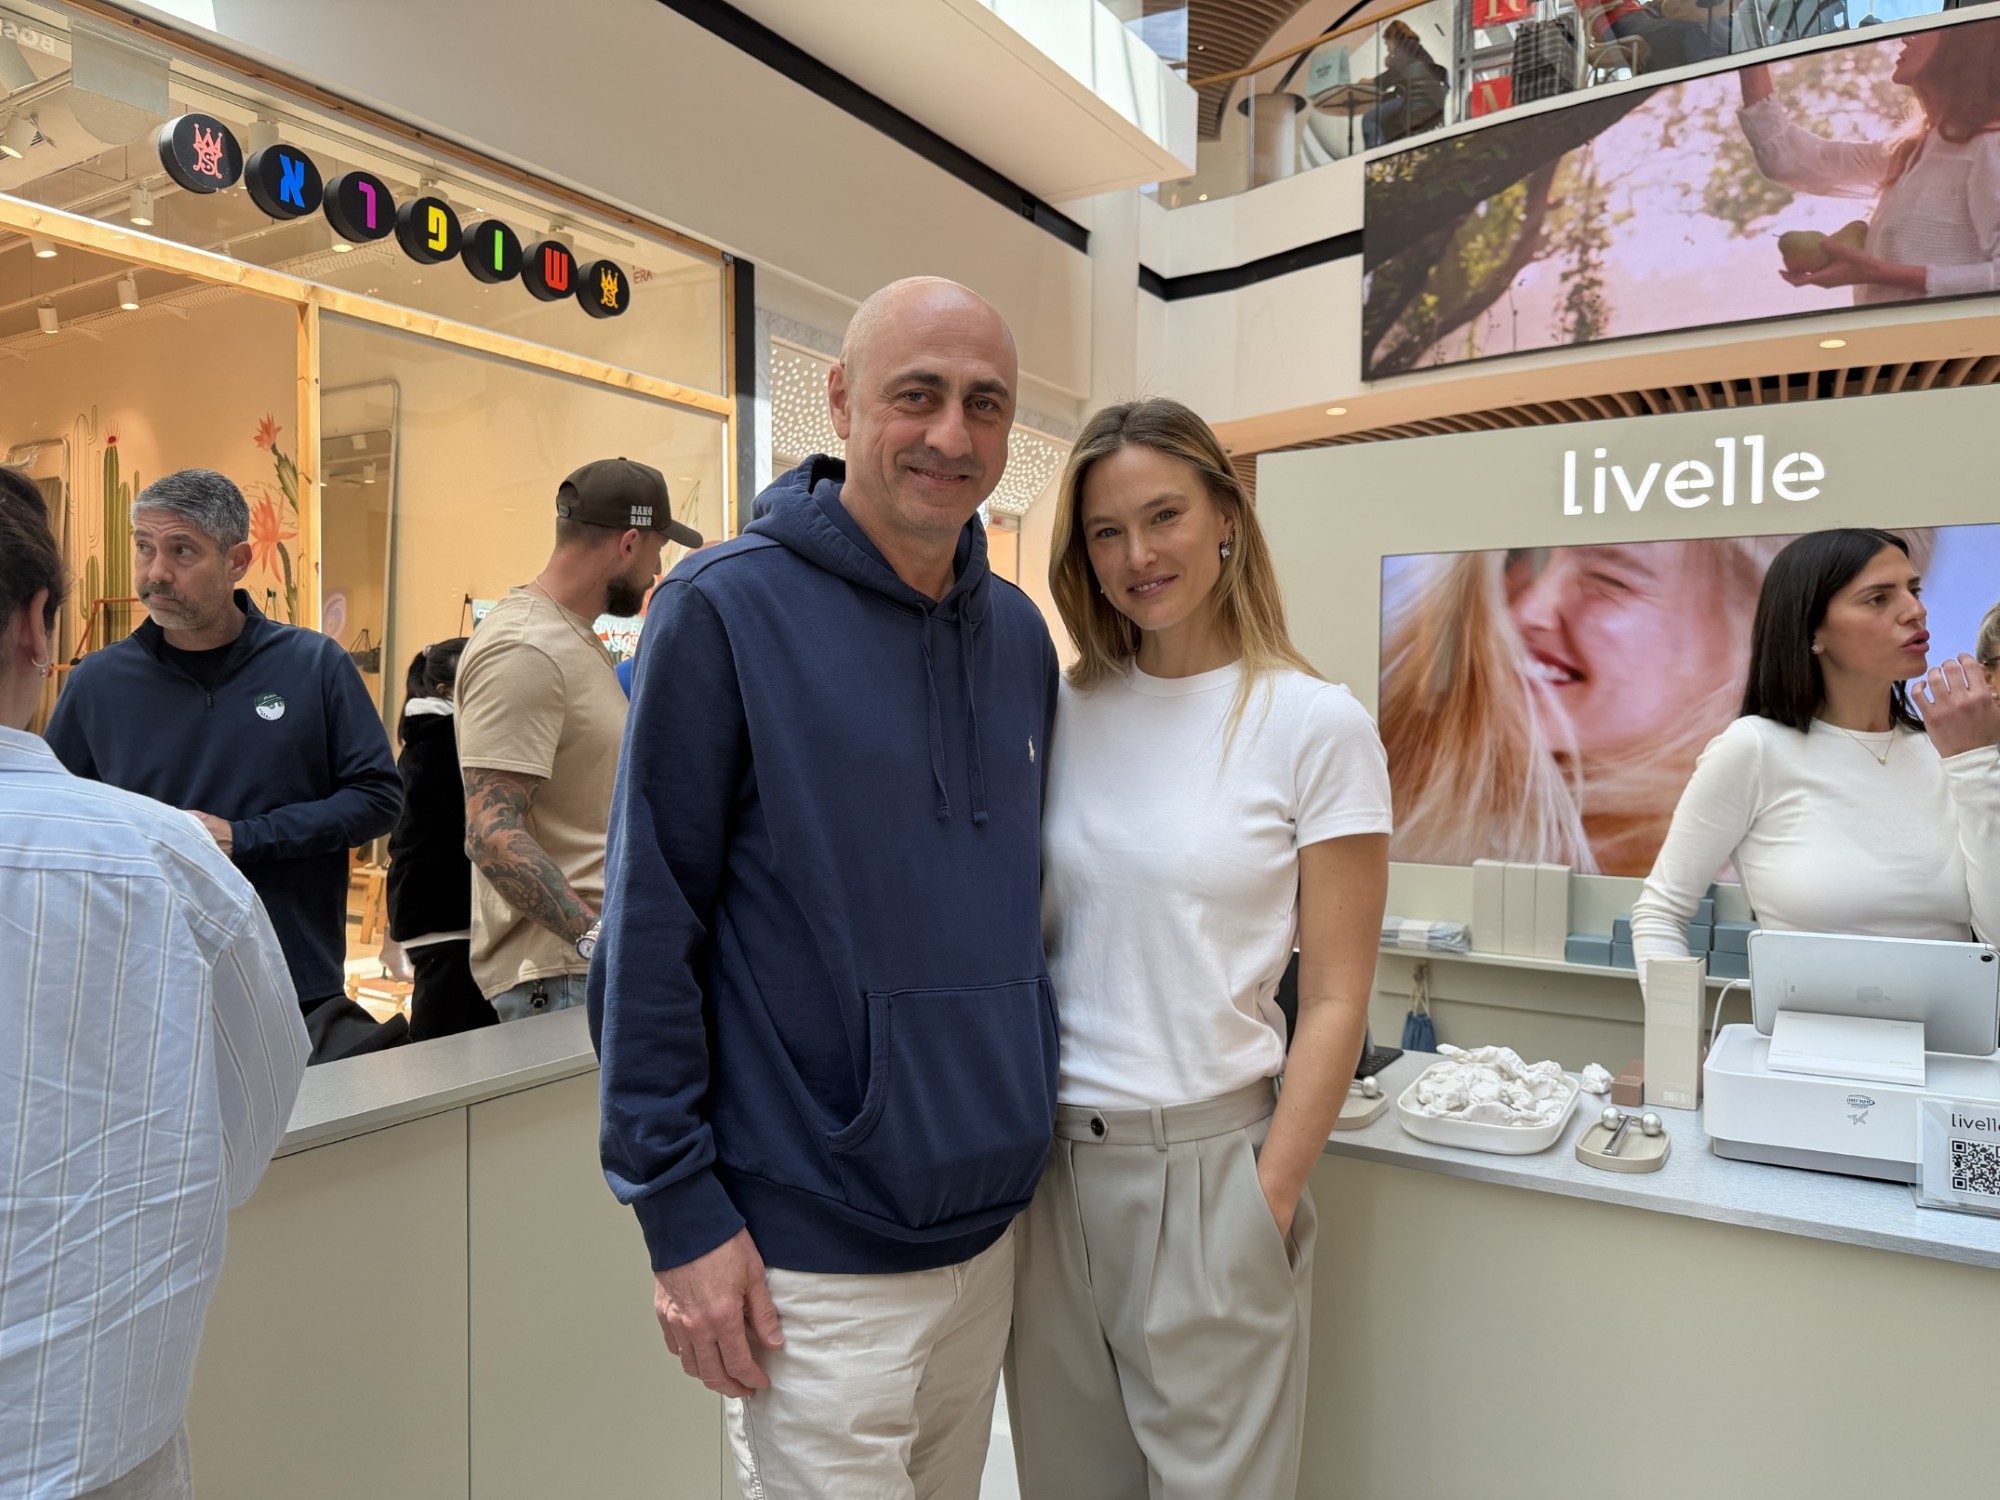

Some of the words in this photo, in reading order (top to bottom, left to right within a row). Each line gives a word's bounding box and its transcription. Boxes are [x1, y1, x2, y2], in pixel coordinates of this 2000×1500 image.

[1563, 434, 1826, 516] livelle
[631, 505, 653, 516] BANG
[630, 515, 652, 526] BANG
[1951, 1113, 2000, 1132] livell
